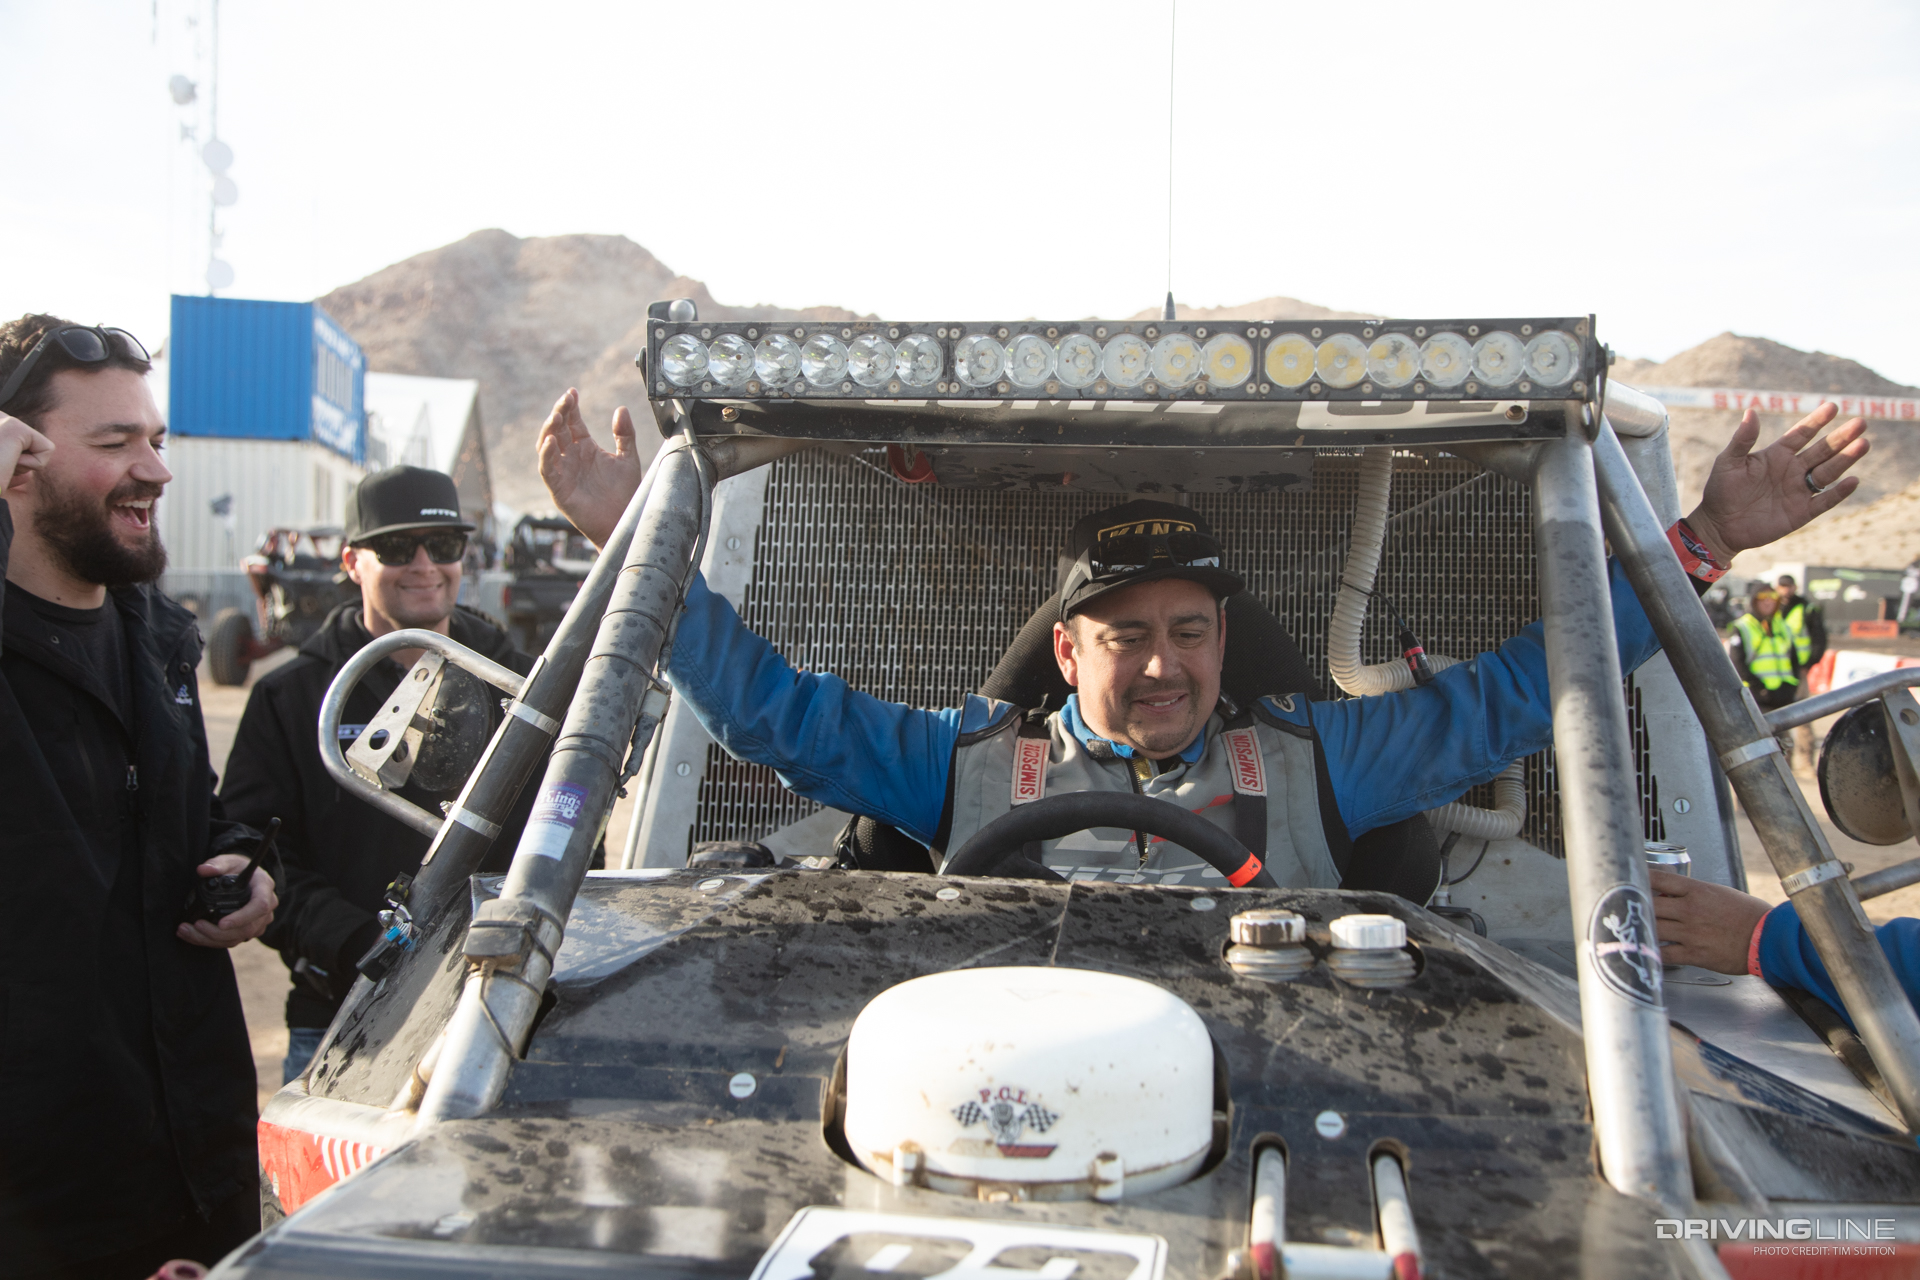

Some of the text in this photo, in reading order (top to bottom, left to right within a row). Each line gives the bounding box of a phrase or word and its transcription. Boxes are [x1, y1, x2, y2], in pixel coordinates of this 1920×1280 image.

[1713, 393, 1802, 413] START
[1841, 397, 1920, 419] FINIS
[1109, 522, 1192, 538] KIN
[1019, 743, 1041, 796] SIMPSON
[1232, 734, 1258, 788] SIMPSON
